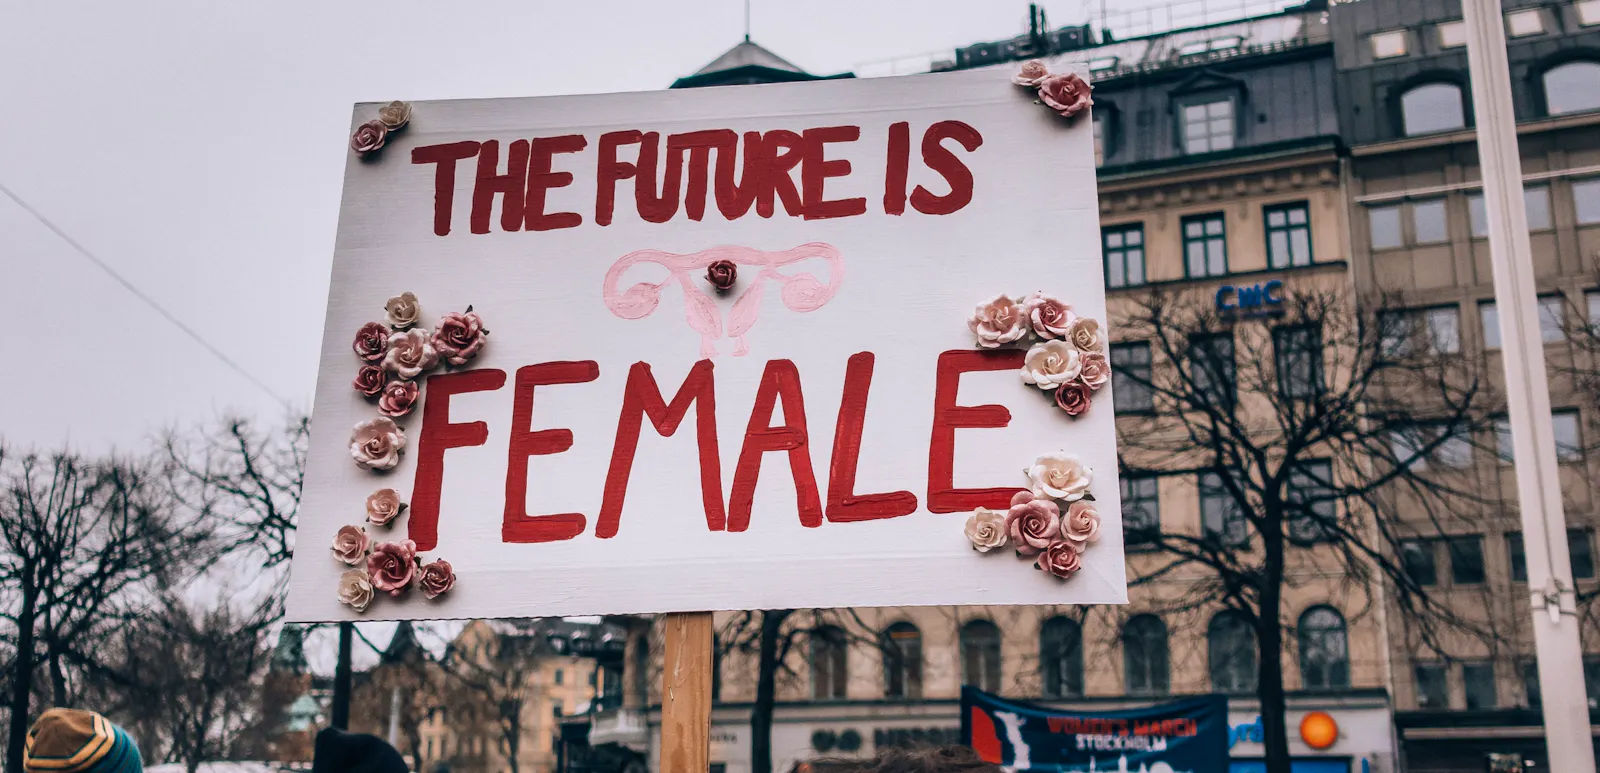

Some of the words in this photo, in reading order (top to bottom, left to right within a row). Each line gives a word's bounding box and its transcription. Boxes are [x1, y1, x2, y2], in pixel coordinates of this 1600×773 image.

[411, 133, 589, 236] THE
[595, 124, 868, 227] FUTURE
[883, 119, 984, 217] IS
[1216, 279, 1283, 311] CWC
[407, 349, 1030, 552] FEMALE
[1047, 716, 1129, 736] WOMEN'S
[1133, 718, 1197, 736] MARCH
[1076, 733, 1167, 752] STOCKHOLM
